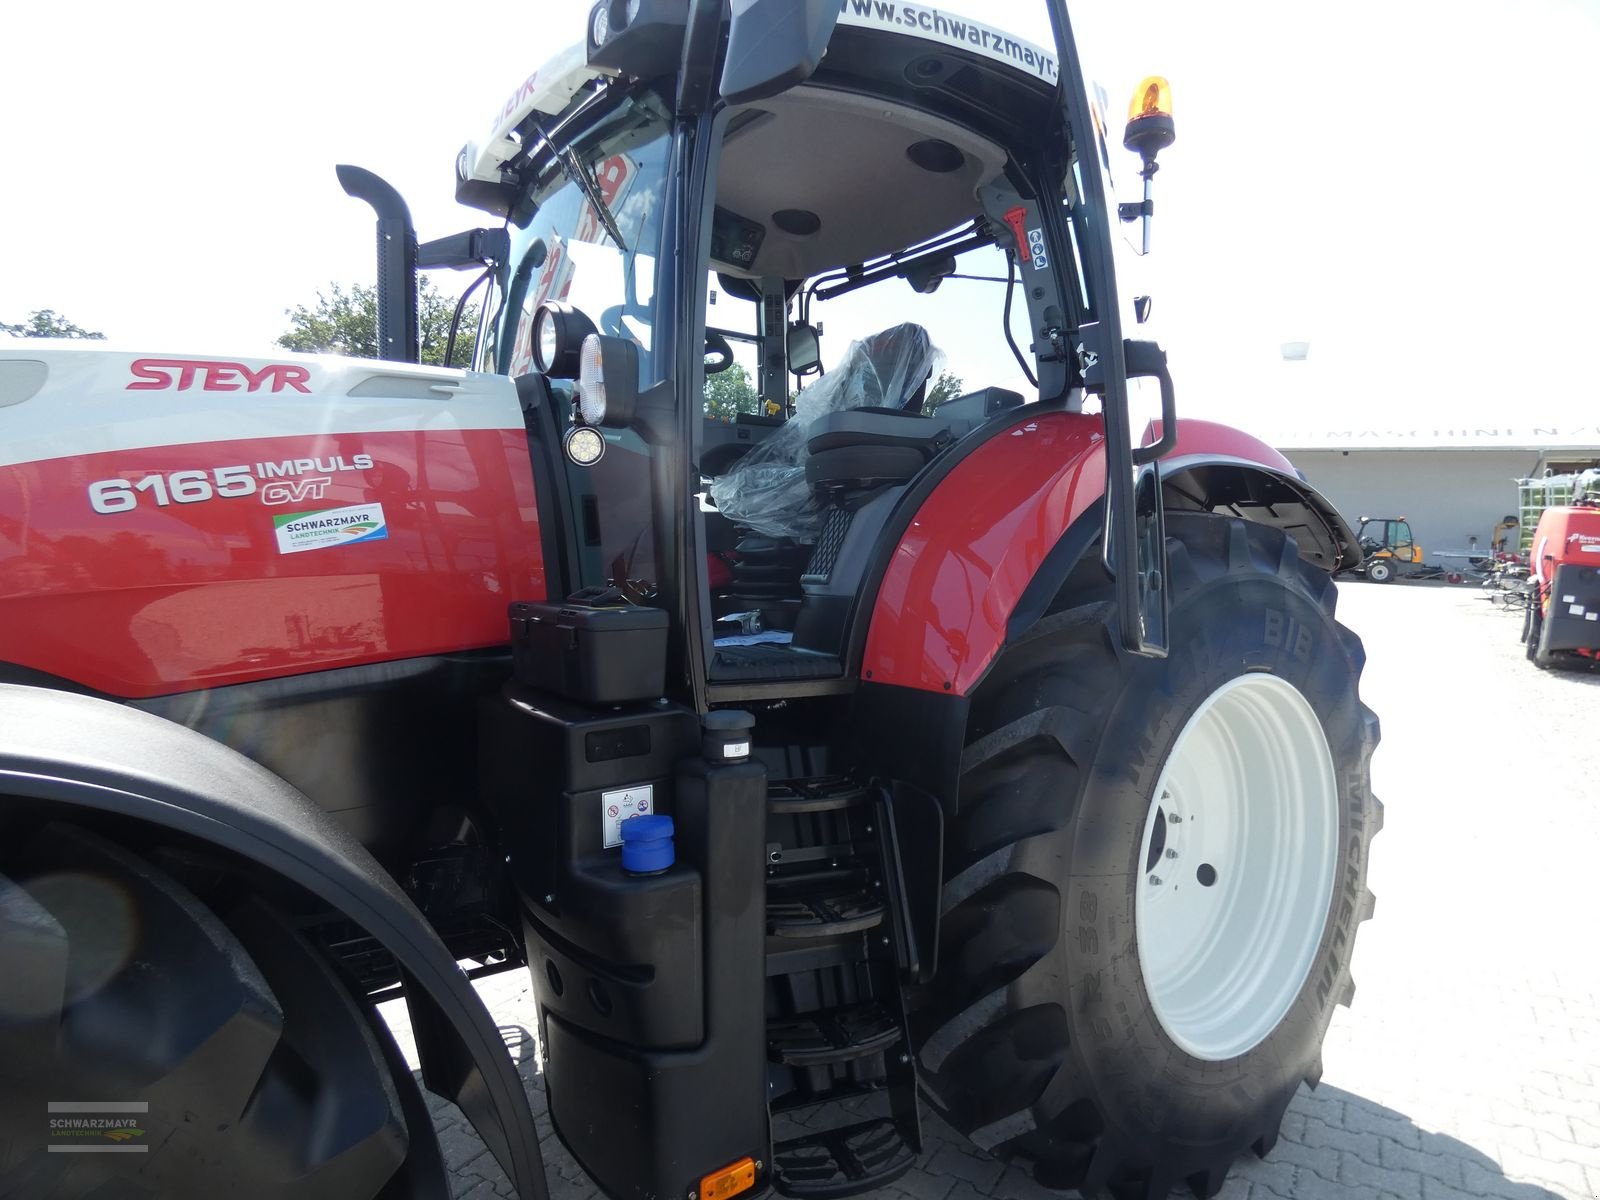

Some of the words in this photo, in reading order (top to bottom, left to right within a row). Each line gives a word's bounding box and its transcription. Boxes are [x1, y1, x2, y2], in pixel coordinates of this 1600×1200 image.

[841, 0, 1058, 77] ww.schwarzmayr.
[125, 358, 312, 394] STEYR
[88, 465, 257, 515] 6165
[256, 453, 374, 479] IMPULS
[261, 477, 332, 506] CVT
[286, 514, 370, 533] SCHWARZMAYR
[290, 527, 340, 540] LANDTECHNIK
[1264, 607, 1313, 665] BIB
[1314, 773, 1364, 1012] MICHELIN
[1078, 889, 1099, 956] 38
